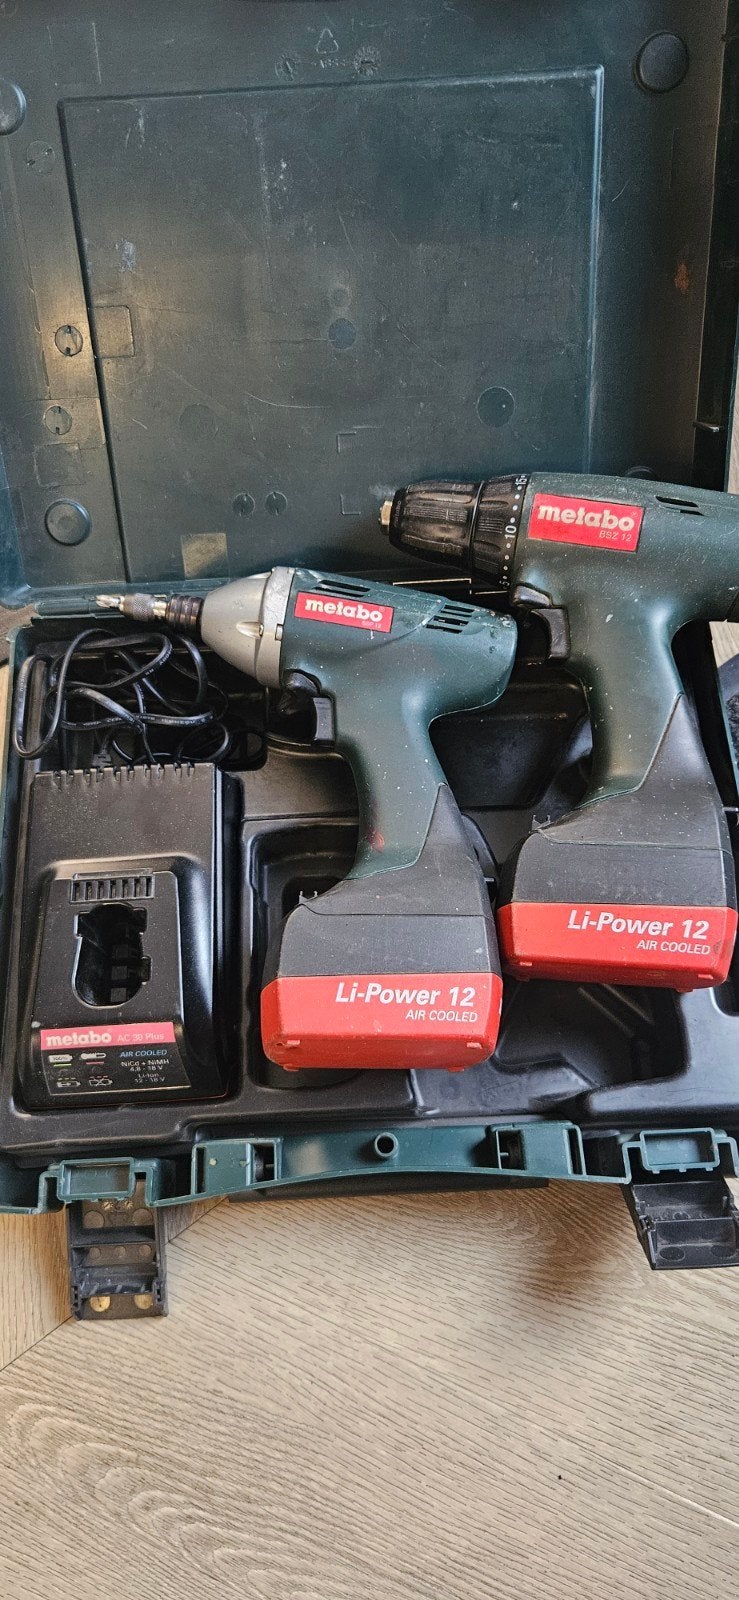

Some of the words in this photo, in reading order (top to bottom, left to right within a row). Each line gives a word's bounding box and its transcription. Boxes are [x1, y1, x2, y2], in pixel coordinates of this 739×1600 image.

[538, 504, 635, 531] metabo
[505, 525, 517, 539] 10
[599, 531, 618, 540] BSZ
[621, 533, 632, 542] 12
[305, 598, 383, 622] metabo
[567, 909, 674, 936] Li-Power
[682, 919, 710, 940] 12
[636, 939, 657, 951] AIR
[660, 941, 711, 955] COOLED
[335, 981, 441, 1006] Li-Power
[449, 986, 476, 1007] 12
[405, 1009, 426, 1021] AIR
[429, 1010, 479, 1023] COOLED
[46, 1030, 112, 1047] metabo
[117, 1034, 131, 1042] AC
[145, 1032, 165, 1041] Plus
[119, 1050, 134, 1058] AIR
[135, 1049, 168, 1057] COOLED
